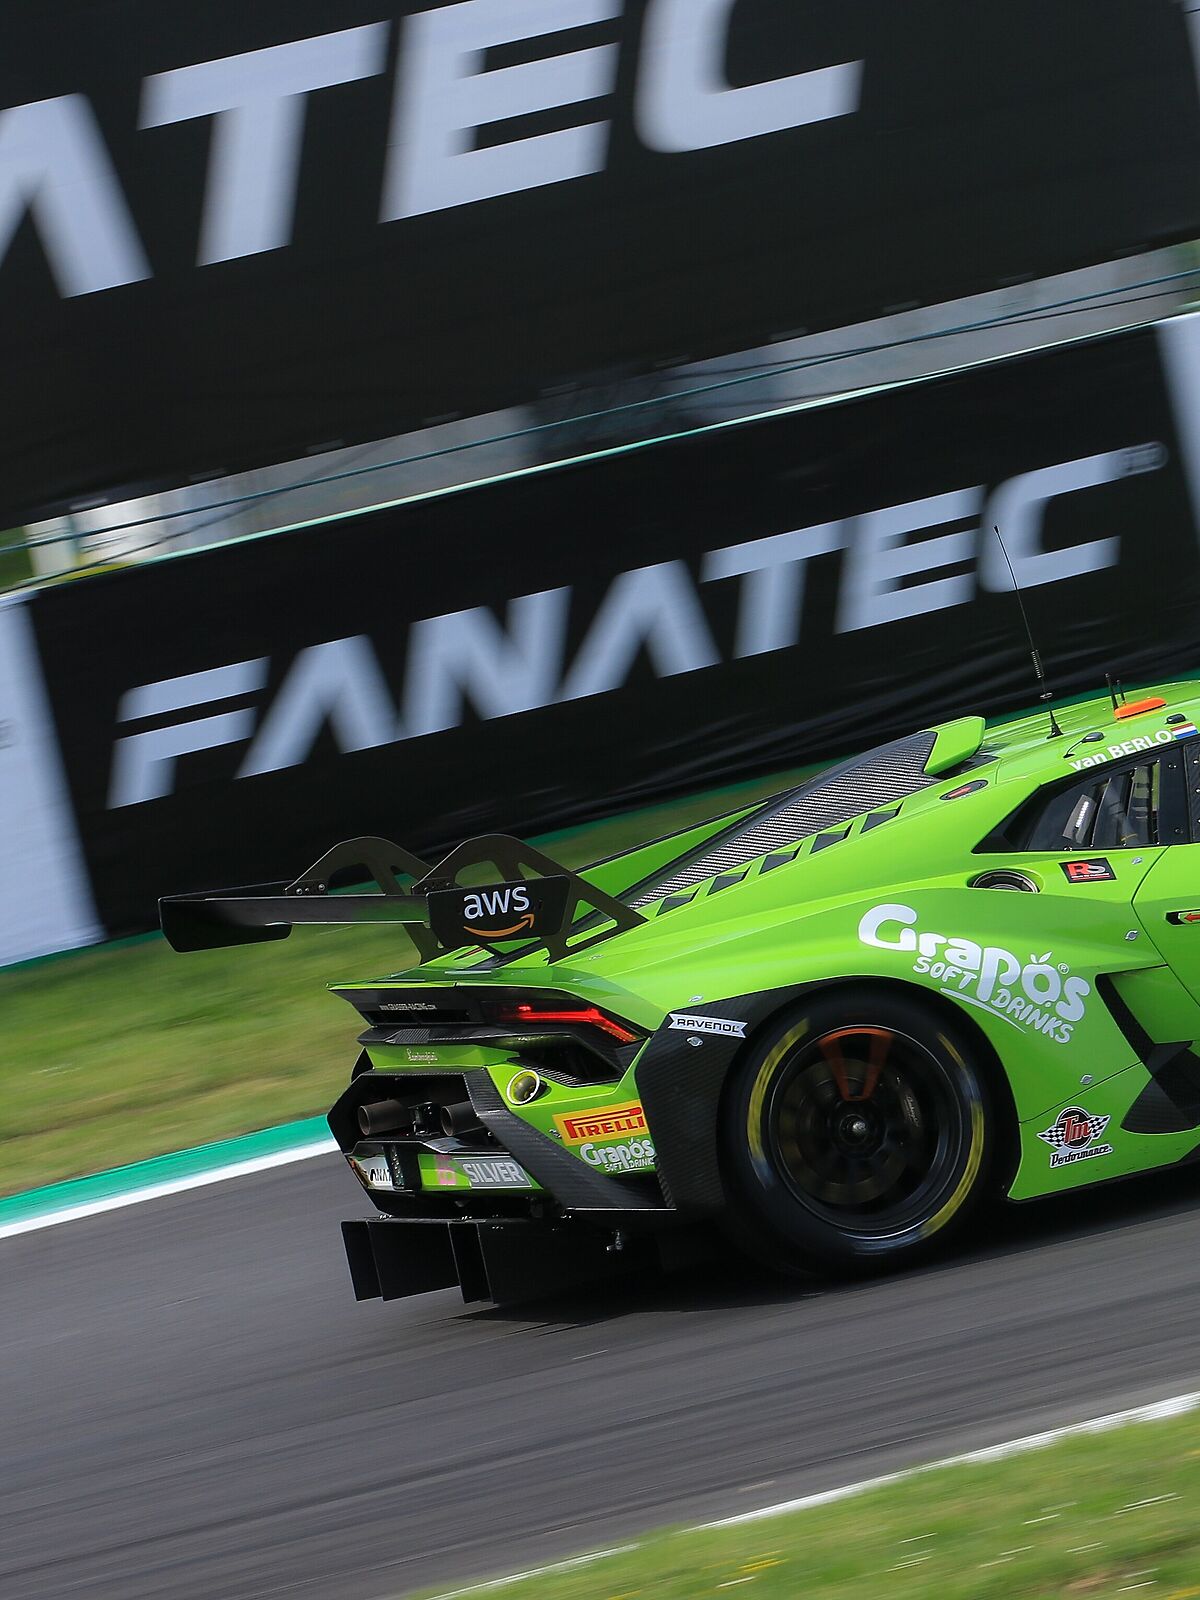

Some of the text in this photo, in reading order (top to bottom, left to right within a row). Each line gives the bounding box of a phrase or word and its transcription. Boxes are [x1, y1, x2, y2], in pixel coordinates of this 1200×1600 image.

[107, 452, 1122, 808] FANATEC
[1069, 730, 1173, 772] van BERLO
[463, 886, 530, 920] aws
[912, 956, 978, 990] SOFT
[676, 1018, 740, 1033] RAVENOL
[991, 988, 1075, 1044] DRINKS
[563, 1106, 645, 1139] PIRELLI
[462, 1162, 526, 1183] SILVER
